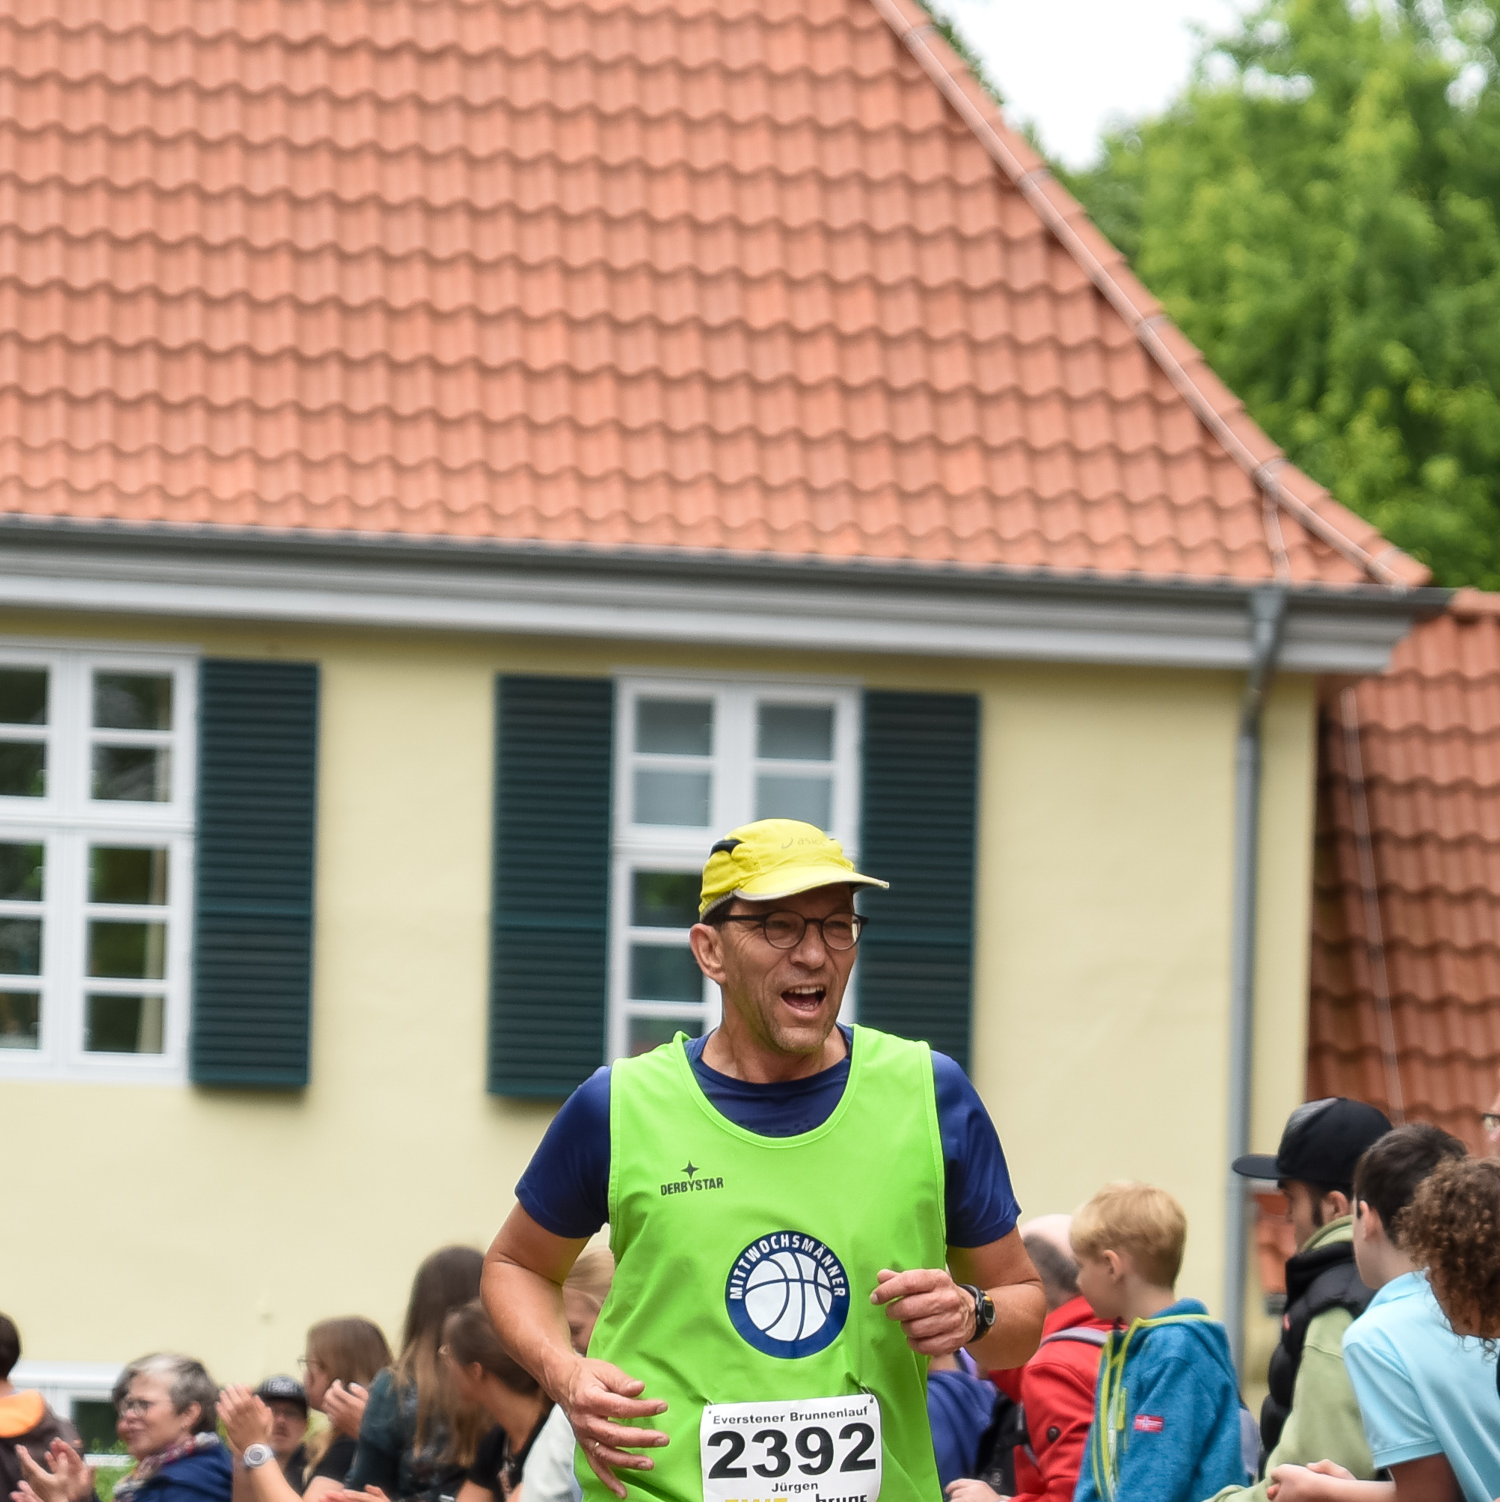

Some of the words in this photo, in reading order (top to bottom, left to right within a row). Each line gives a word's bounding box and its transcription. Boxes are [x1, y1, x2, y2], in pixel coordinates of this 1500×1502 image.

[660, 1177, 724, 1196] DERBYSTAR
[729, 1233, 846, 1300] MITTWOCHSMÄNNER
[713, 1414, 785, 1425] Everstener
[790, 1406, 868, 1422] Brunnenlauf
[707, 1422, 876, 1479] 2392
[771, 1483, 819, 1494] Jürgen
